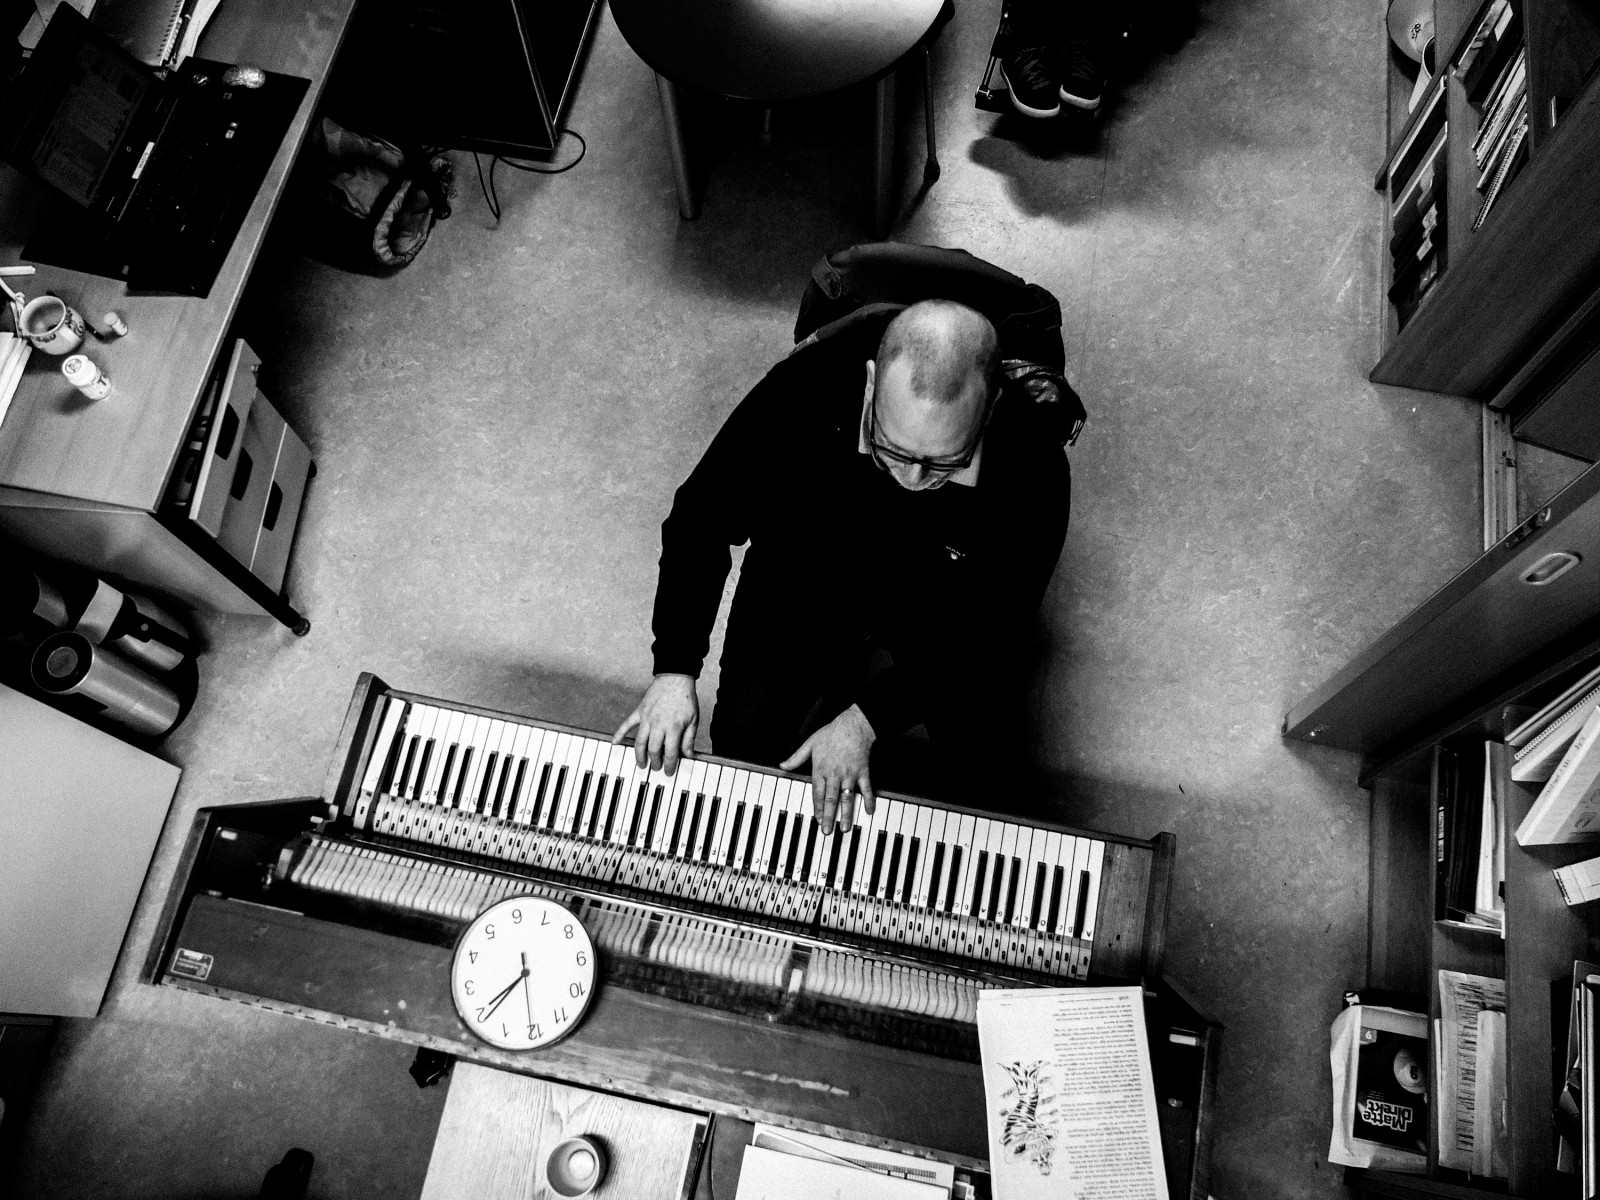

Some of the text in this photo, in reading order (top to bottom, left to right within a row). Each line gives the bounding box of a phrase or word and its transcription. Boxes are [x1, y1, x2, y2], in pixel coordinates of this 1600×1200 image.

[512, 909, 522, 924] 6
[541, 910, 550, 925] 7
[485, 924, 495, 939] 5
[564, 924, 574, 939] 8
[469, 950, 478, 964] 4
[576, 951, 586, 966] 9
[465, 980, 475, 995] 3
[569, 981, 585, 998] 10
[476, 1007, 486, 1023] 2
[554, 1007, 568, 1024] 11
[502, 1023, 509, 1037] 1
[527, 1023, 544, 1040] 12
[1367, 1100, 1412, 1122] Direkt
[1362, 1111, 1406, 1131] Matte
